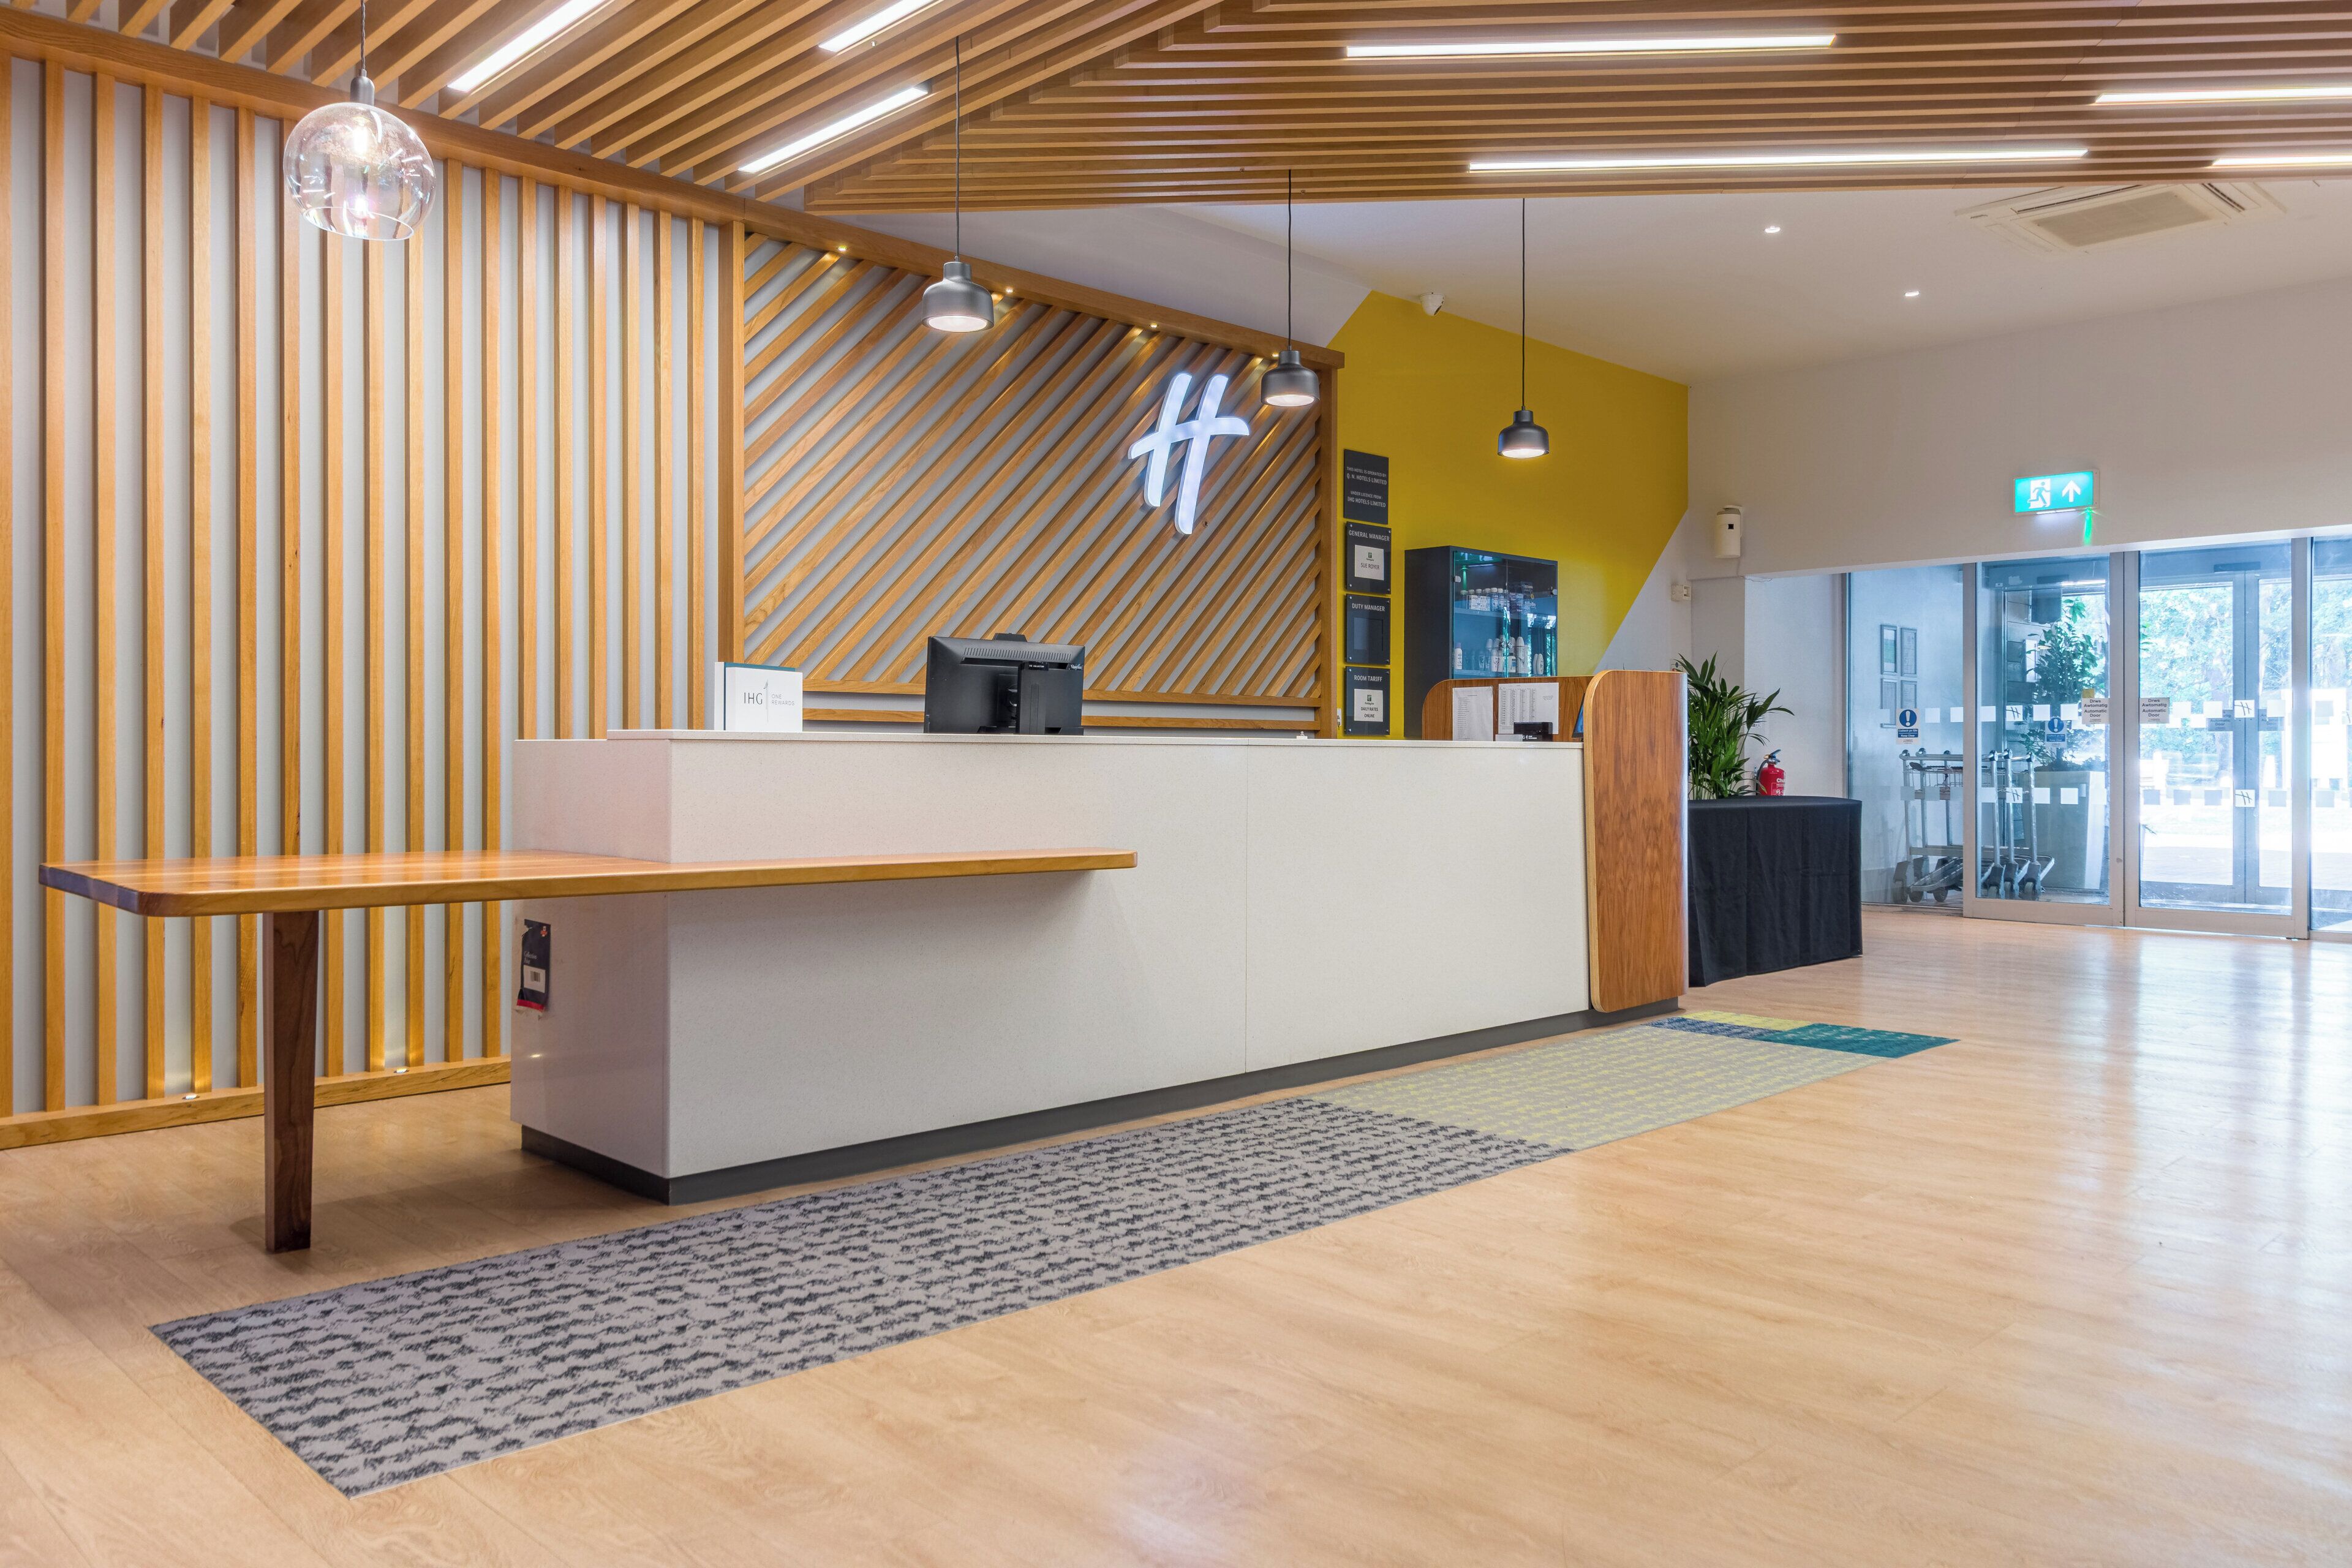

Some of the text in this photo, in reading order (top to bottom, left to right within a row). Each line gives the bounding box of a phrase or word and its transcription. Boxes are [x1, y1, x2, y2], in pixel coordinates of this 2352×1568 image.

[1349, 530, 1390, 541] GENERAL MANAGER
[744, 692, 763, 705] IHG
